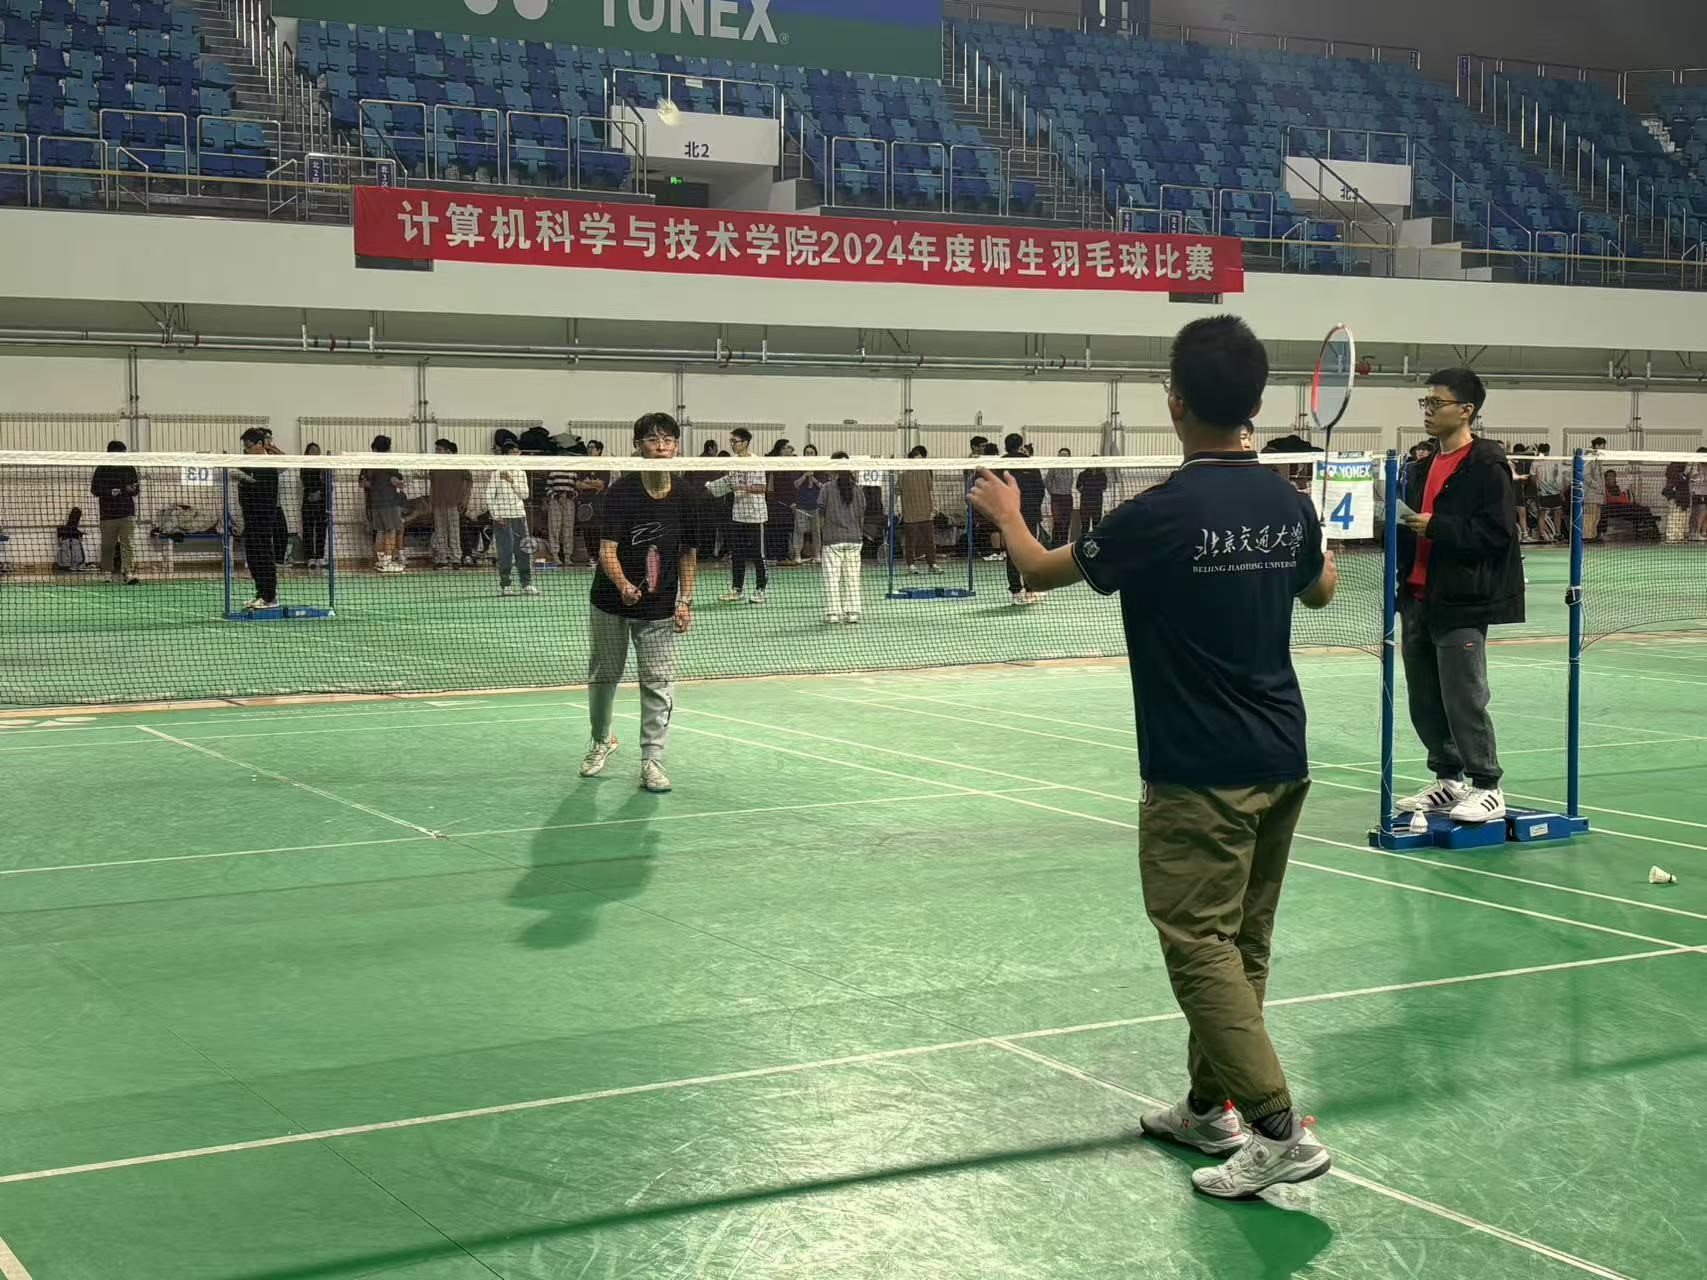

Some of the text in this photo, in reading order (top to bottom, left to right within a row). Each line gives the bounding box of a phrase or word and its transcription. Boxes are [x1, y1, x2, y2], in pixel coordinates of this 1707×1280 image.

[684, 141, 710, 158] 北2
[398, 200, 1215, 281] 计算机科学与技术学院2024年度师生羽毛球比赛
[1338, 464, 1372, 479] YONEX
[1330, 492, 1354, 530] 4
